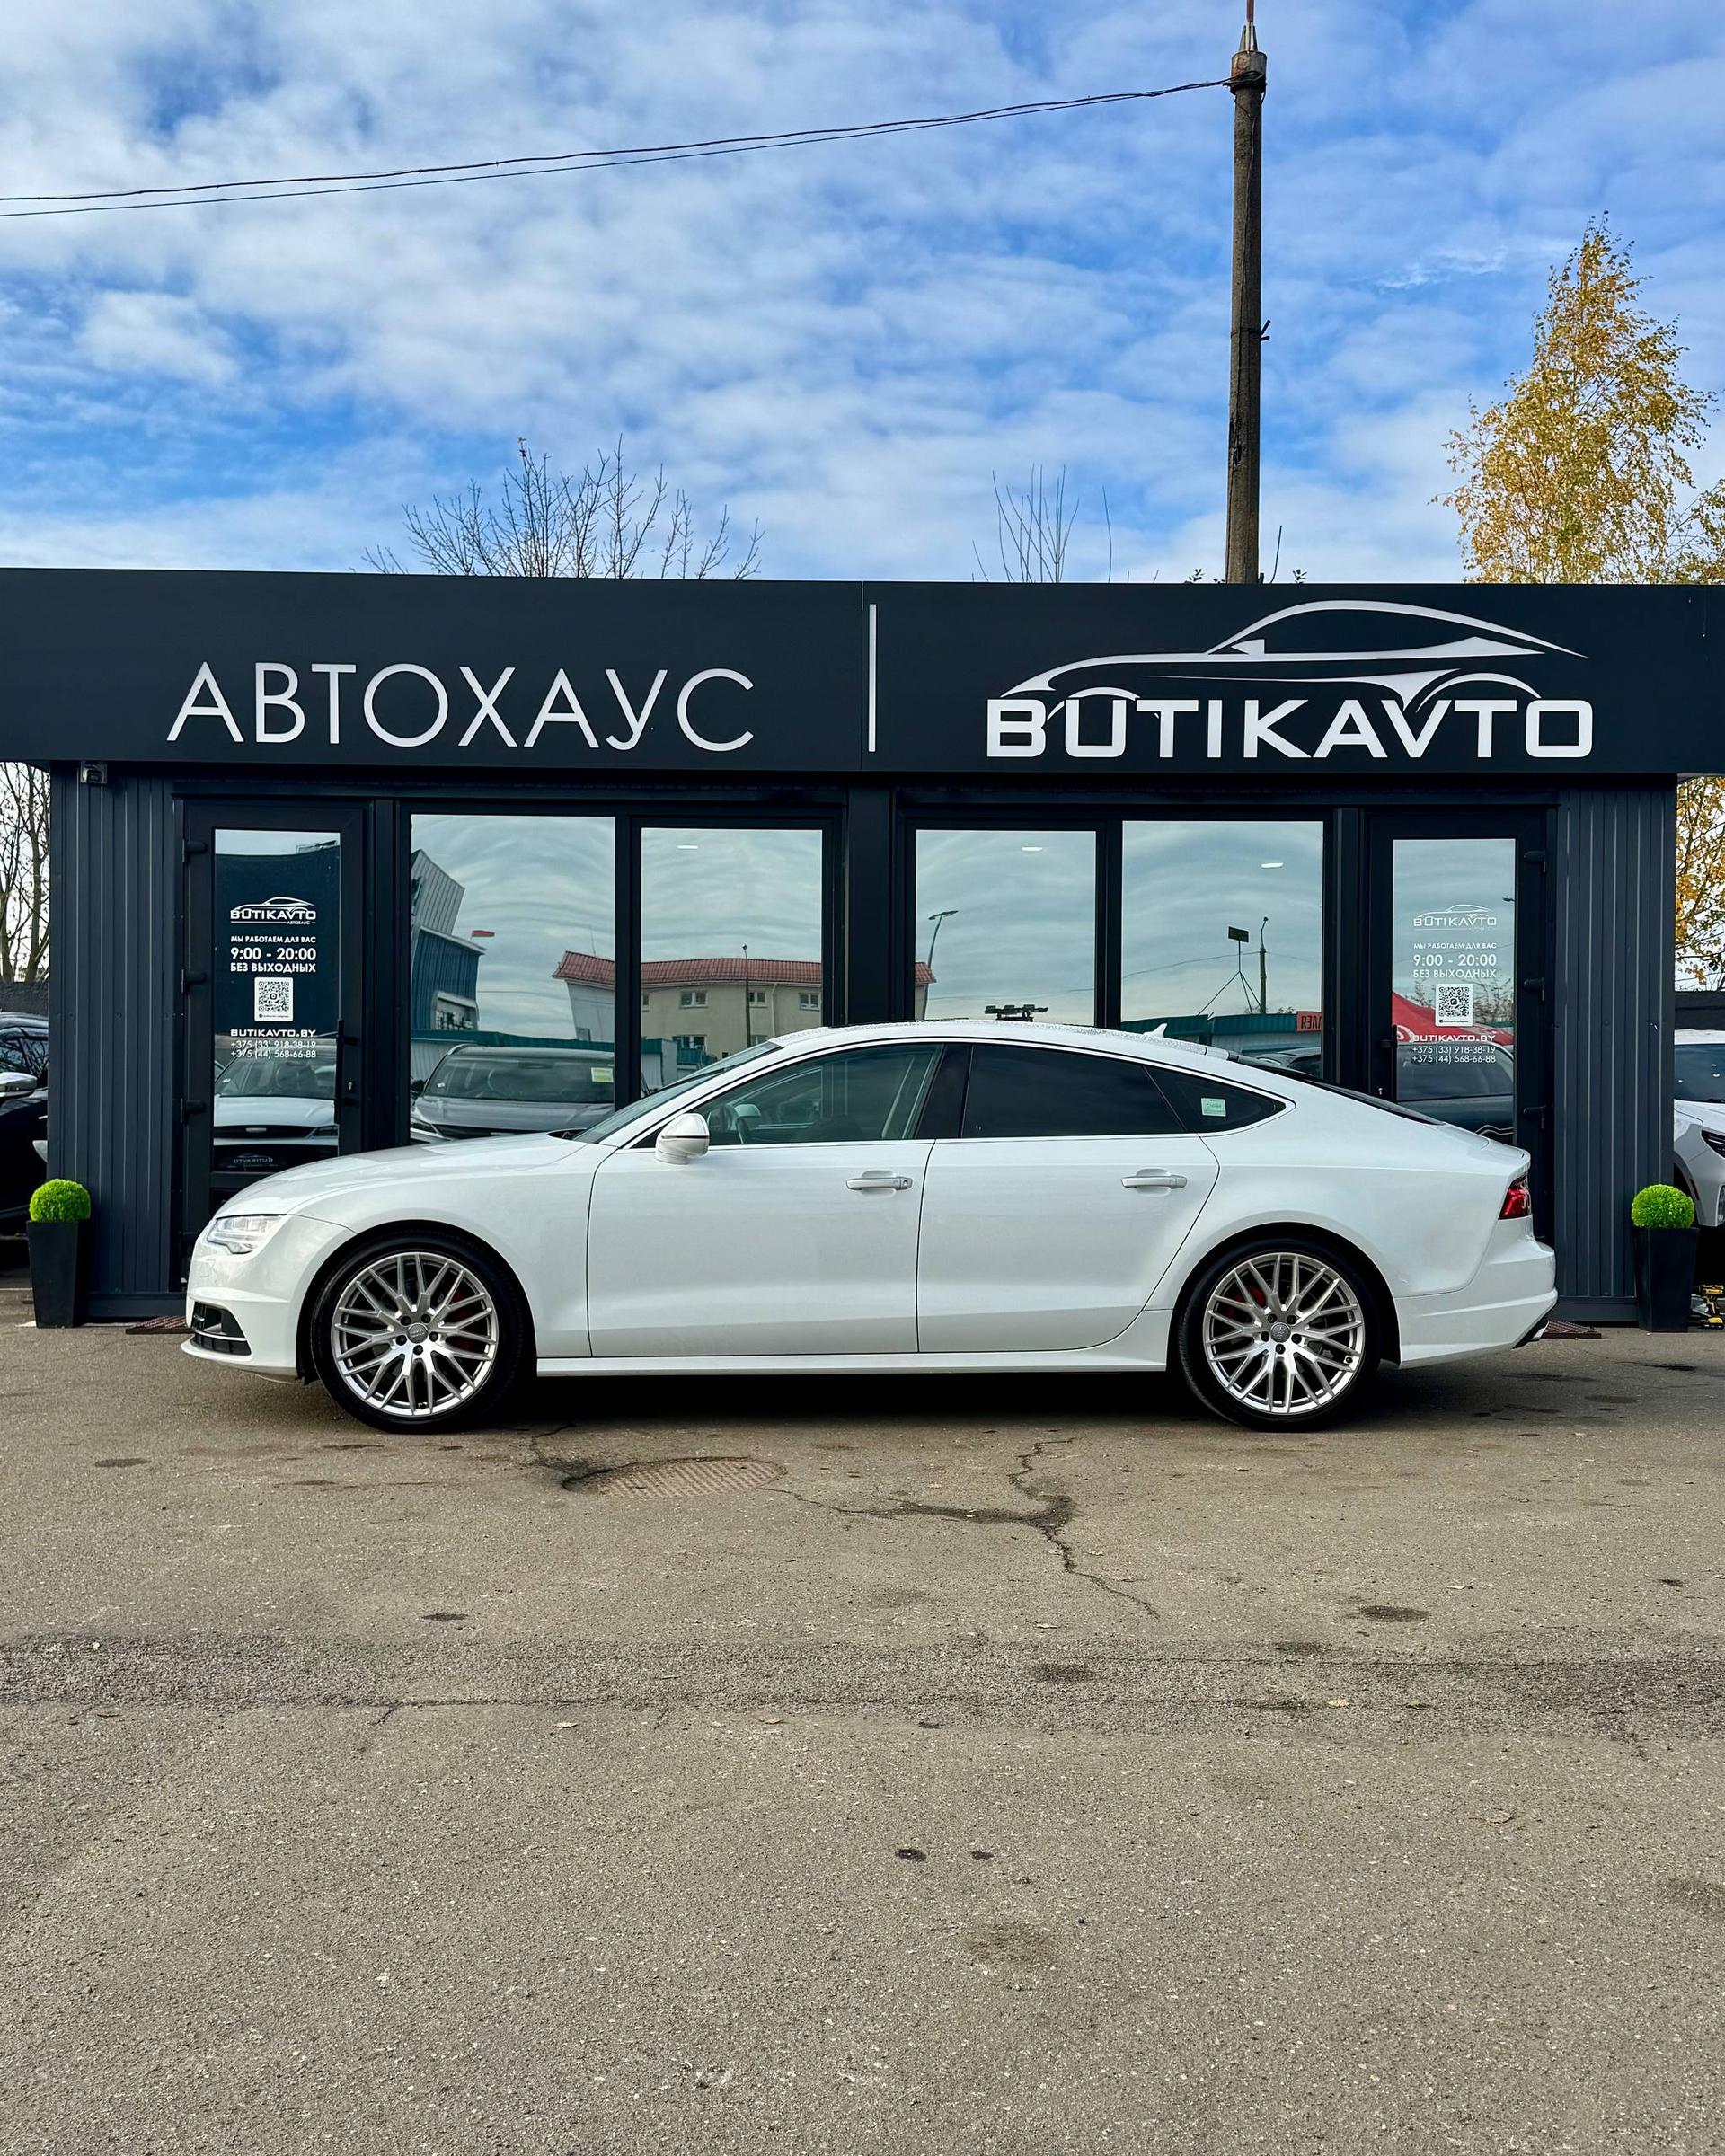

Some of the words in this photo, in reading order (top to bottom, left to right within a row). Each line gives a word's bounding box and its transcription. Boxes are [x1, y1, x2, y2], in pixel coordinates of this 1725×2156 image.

[167, 662, 754, 752] АВТОХАУС
[986, 698, 1593, 758] BUTIKAVTO
[230, 910, 317, 920] BUTIKAVTO
[1413, 917, 1497, 927] BUTIKAVTO
[284, 936, 299, 944] ДЛЯ
[231, 947, 261, 960] 9:00
[277, 947, 316, 960] 20:00
[1413, 954, 1443, 967] 9:00
[1458, 954, 1497, 967] 20:00
[230, 963, 249, 972] БЕЗ
[252, 963, 316, 973] ВЫХОДНЫХ
[1413, 969, 1430, 978] БЕЗ
[1434, 969, 1497, 979] ВЫХОДНЫХ
[1413, 1034, 1495, 1042] BUTIKAVTO.BY
[231, 1040, 252, 1048] +375
[255, 1040, 270, 1050] (33)
[274, 1040, 316, 1048] 918-38-19
[255, 1050, 270, 1059] (44)
[274, 1050, 316, 1058] 568-66-88
[1412, 1046, 1433, 1054] +375
[1436, 1046, 1452, 1055] (33)
[1454, 1046, 1495, 1054] 918-38-19
[1412, 1055, 1433, 1063] +375
[1436, 1055, 1452, 1064] (44)
[1454, 1055, 1495, 1063] 568-66-88
